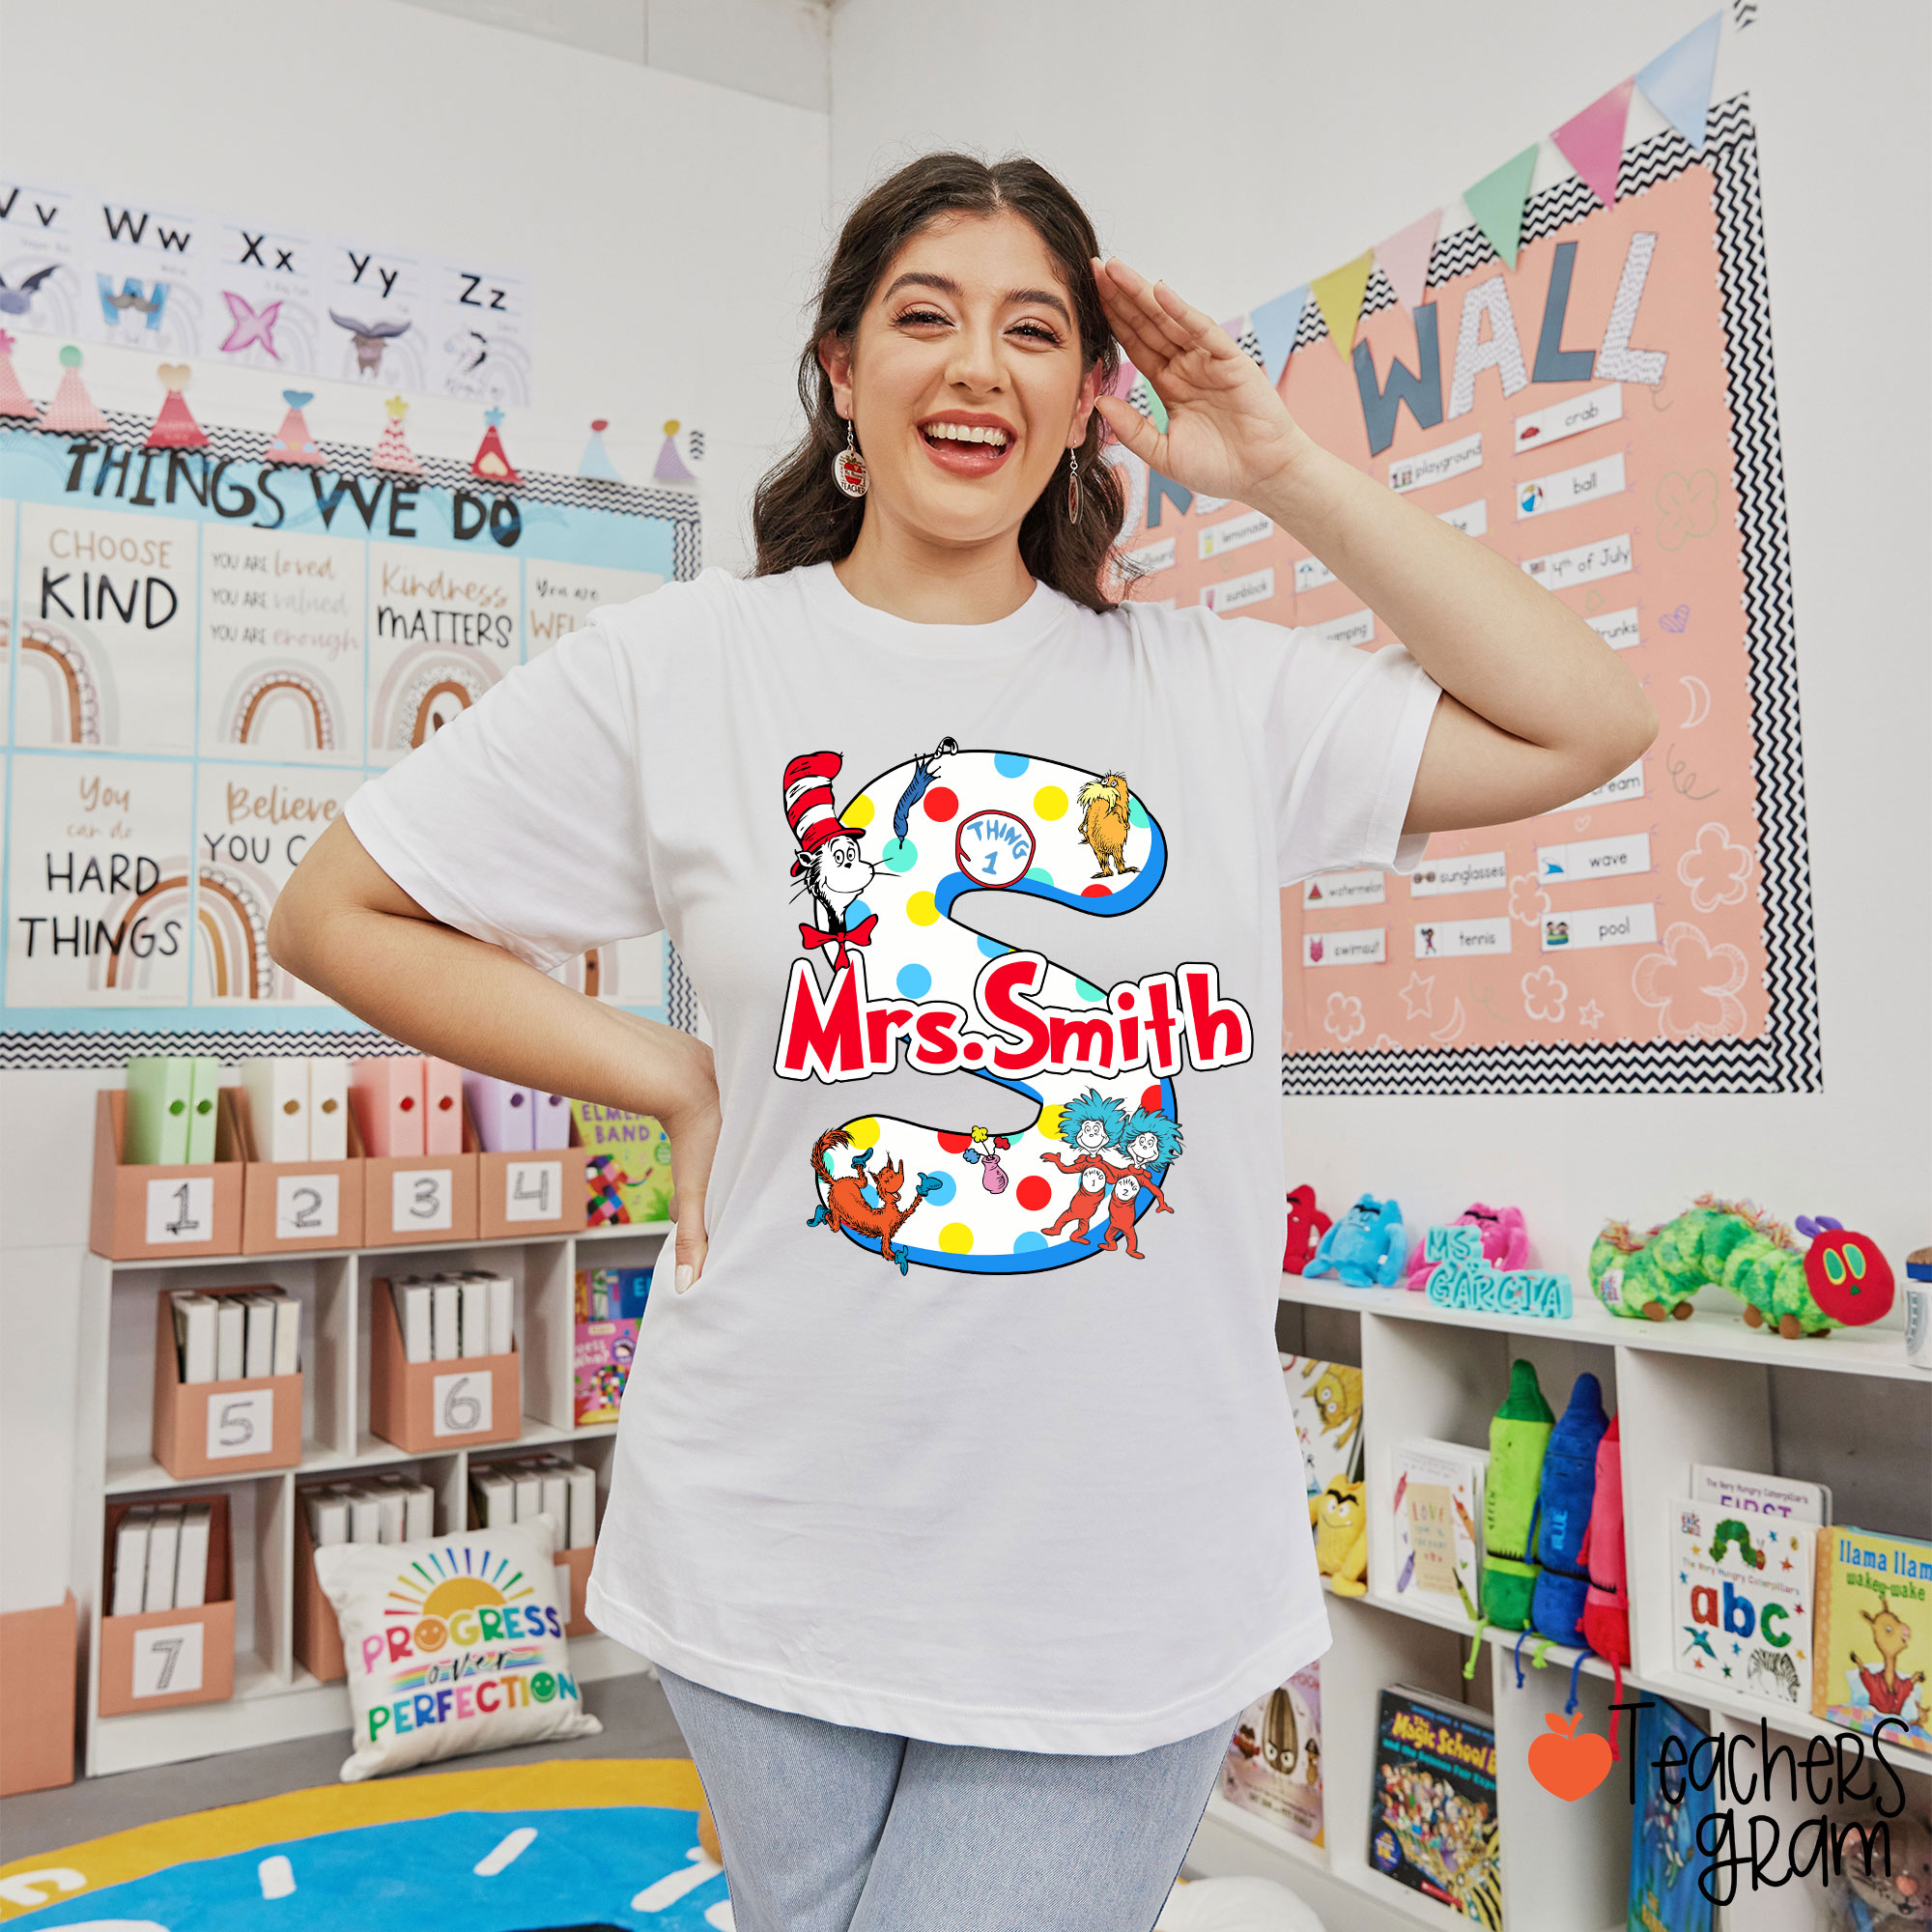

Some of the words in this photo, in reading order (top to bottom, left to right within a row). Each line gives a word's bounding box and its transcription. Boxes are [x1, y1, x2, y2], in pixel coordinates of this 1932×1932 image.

[1351, 231, 1668, 457] WALL
[1565, 401, 1599, 427] crab
[1414, 439, 1483, 478] playground
[65, 442, 285, 529] THINGS
[310, 469, 420, 537] WE
[453, 490, 522, 548] DO
[1573, 472, 1598, 495] ball
[49, 528, 173, 570] CHOOSE
[211, 552, 240, 571] YOU
[243, 554, 268, 573] ARE
[273, 549, 335, 582] loved
[1577, 553, 1595, 573] of
[1601, 545, 1631, 568] July
[41, 566, 178, 630] KIND
[210, 587, 240, 607] YOU
[242, 590, 268, 610] ARE
[381, 560, 510, 610] Kindness
[210, 624, 239, 642] YOU
[242, 626, 267, 645] ARE
[272, 628, 359, 663] enough
[78, 775, 131, 813] You
[225, 780, 339, 826] Believe
[67, 824, 101, 839] can
[110, 821, 133, 840] do
[203, 833, 270, 865] YOU
[967, 819, 1030, 860] THING
[45, 851, 160, 896] HARD
[981, 850, 998, 875] 1
[1439, 864, 1506, 887] sunglasses
[1589, 851, 1629, 867] wave
[1328, 881, 1384, 898] watermelon
[18, 915, 183, 959] THINGS
[1459, 930, 1496, 947] tennis
[1598, 916, 1631, 941] pool
[595, 1124, 650, 1144] BAND
[513, 1169, 550, 1211] 4
[1083, 1169, 1104, 1180] THING
[1119, 1179, 1138, 1191] THING
[165, 1181, 200, 1236] 1
[292, 1186, 323, 1229] 2
[410, 1177, 440, 1219] 3
[1426, 1226, 1478, 1264] MS
[1428, 1264, 1567, 1320] GARCIA
[218, 1401, 254, 1446] 5
[443, 1377, 481, 1431] 6
[1737, 1483, 1761, 1497] Hungry
[1550, 1509, 1568, 1550] BLUE
[1718, 1567, 1747, 1584] Hungry
[1839, 1539, 1888, 1573] llama
[1893, 1550, 1932, 1582] llam
[1690, 1580, 1793, 1649] abc
[361, 1605, 562, 1675] PROGRESS
[151, 1636, 185, 1690] 7
[427, 1650, 510, 1686] over
[368, 1671, 579, 1743] PERFECTION
[1391, 1710, 1436, 1749] Magic
[1435, 1727, 1489, 1770] School
